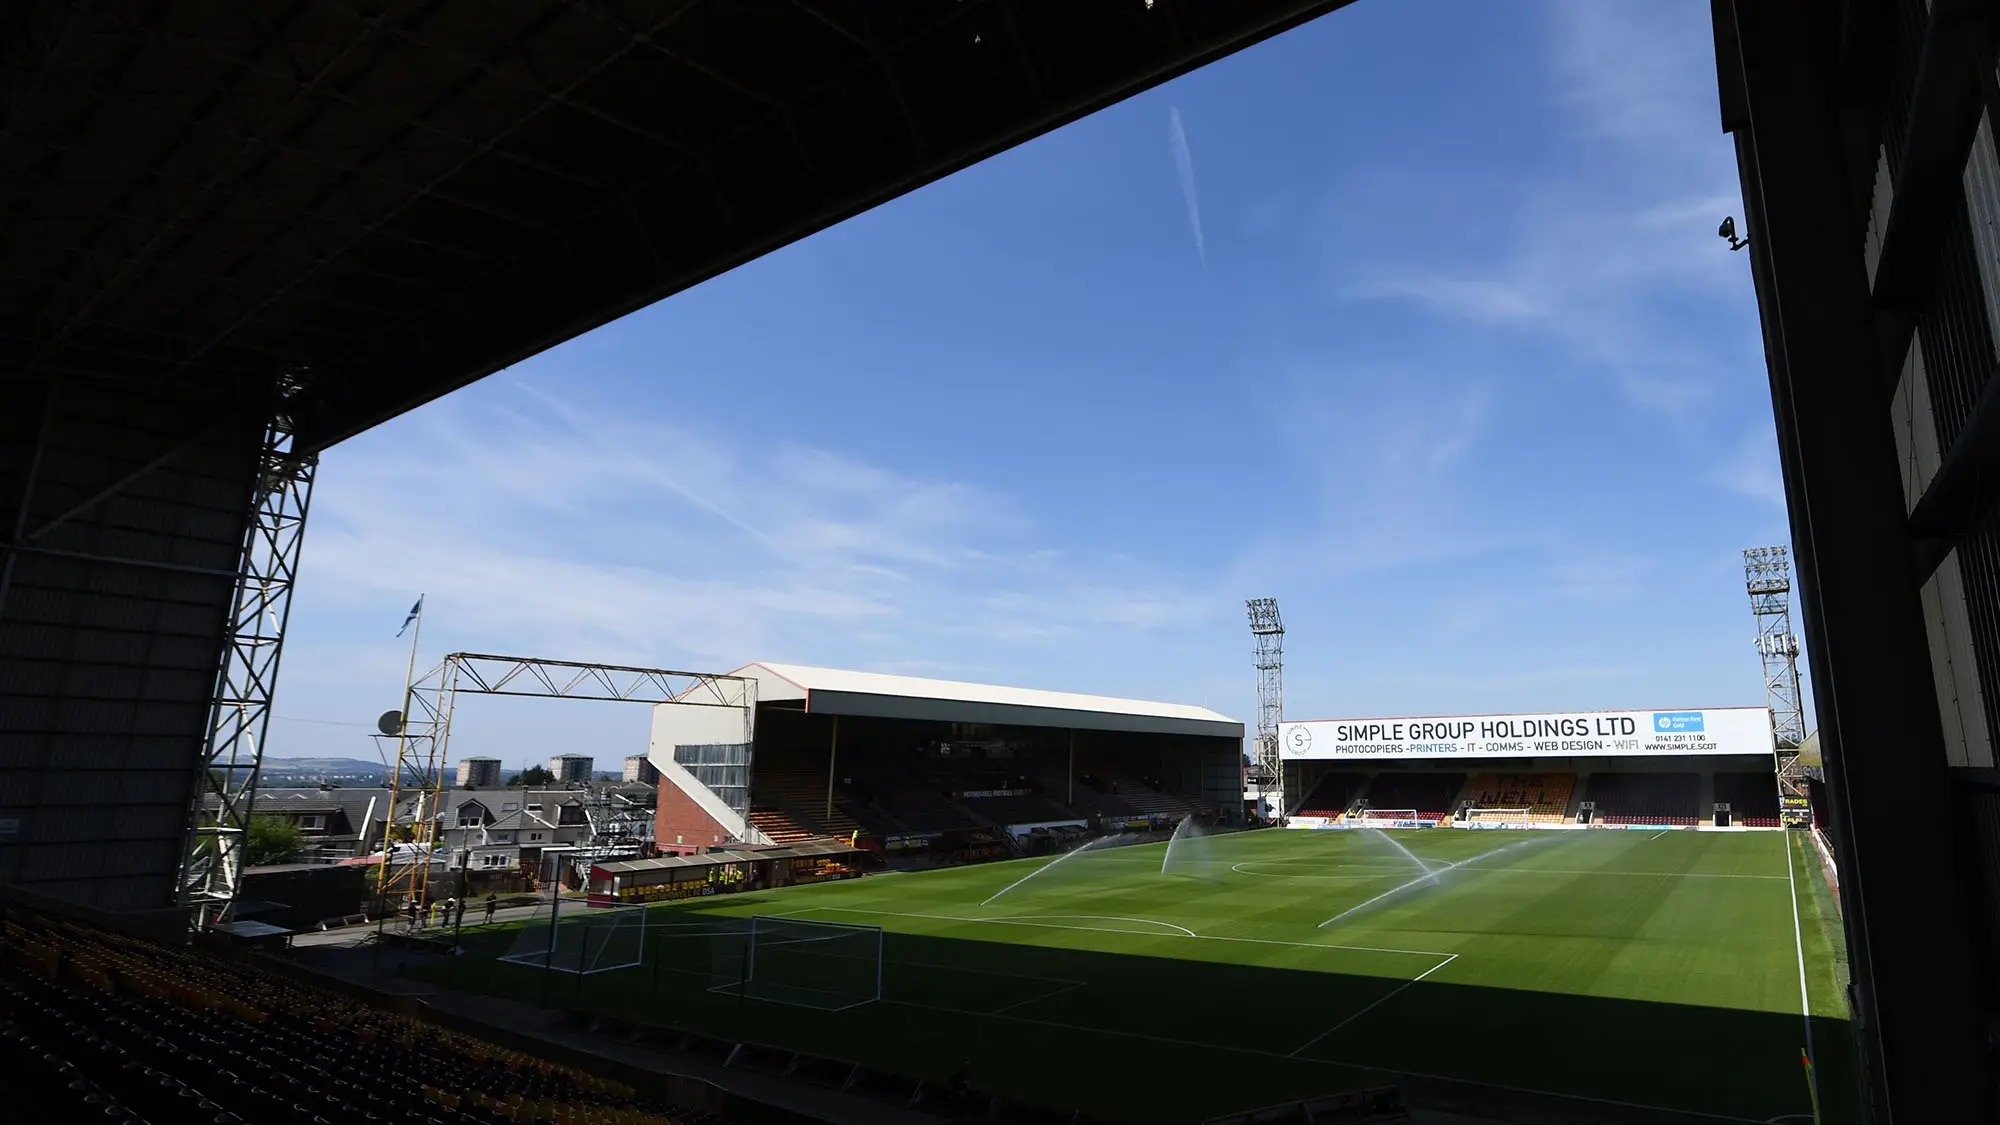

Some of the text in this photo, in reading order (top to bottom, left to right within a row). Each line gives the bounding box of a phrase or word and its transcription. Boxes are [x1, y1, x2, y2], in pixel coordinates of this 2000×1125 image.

[1338, 717, 1635, 742] SIMPLE GROUP HOLDINGS LTD
[1295, 734, 1304, 747] S
[1688, 734, 1706, 742] 1100
[1336, 744, 1403, 754] PHOTOCOPIERS
[1467, 743, 1476, 752] IT
[1486, 742, 1524, 752] COMMS
[1534, 741, 1558, 751] WEB
[1561, 740, 1602, 751] DESIGN
[1613, 739, 1639, 750] WIFI
[1644, 743, 1717, 752] WWW.SIMPLE.SCOT
[1477, 790, 1552, 805] WELL
